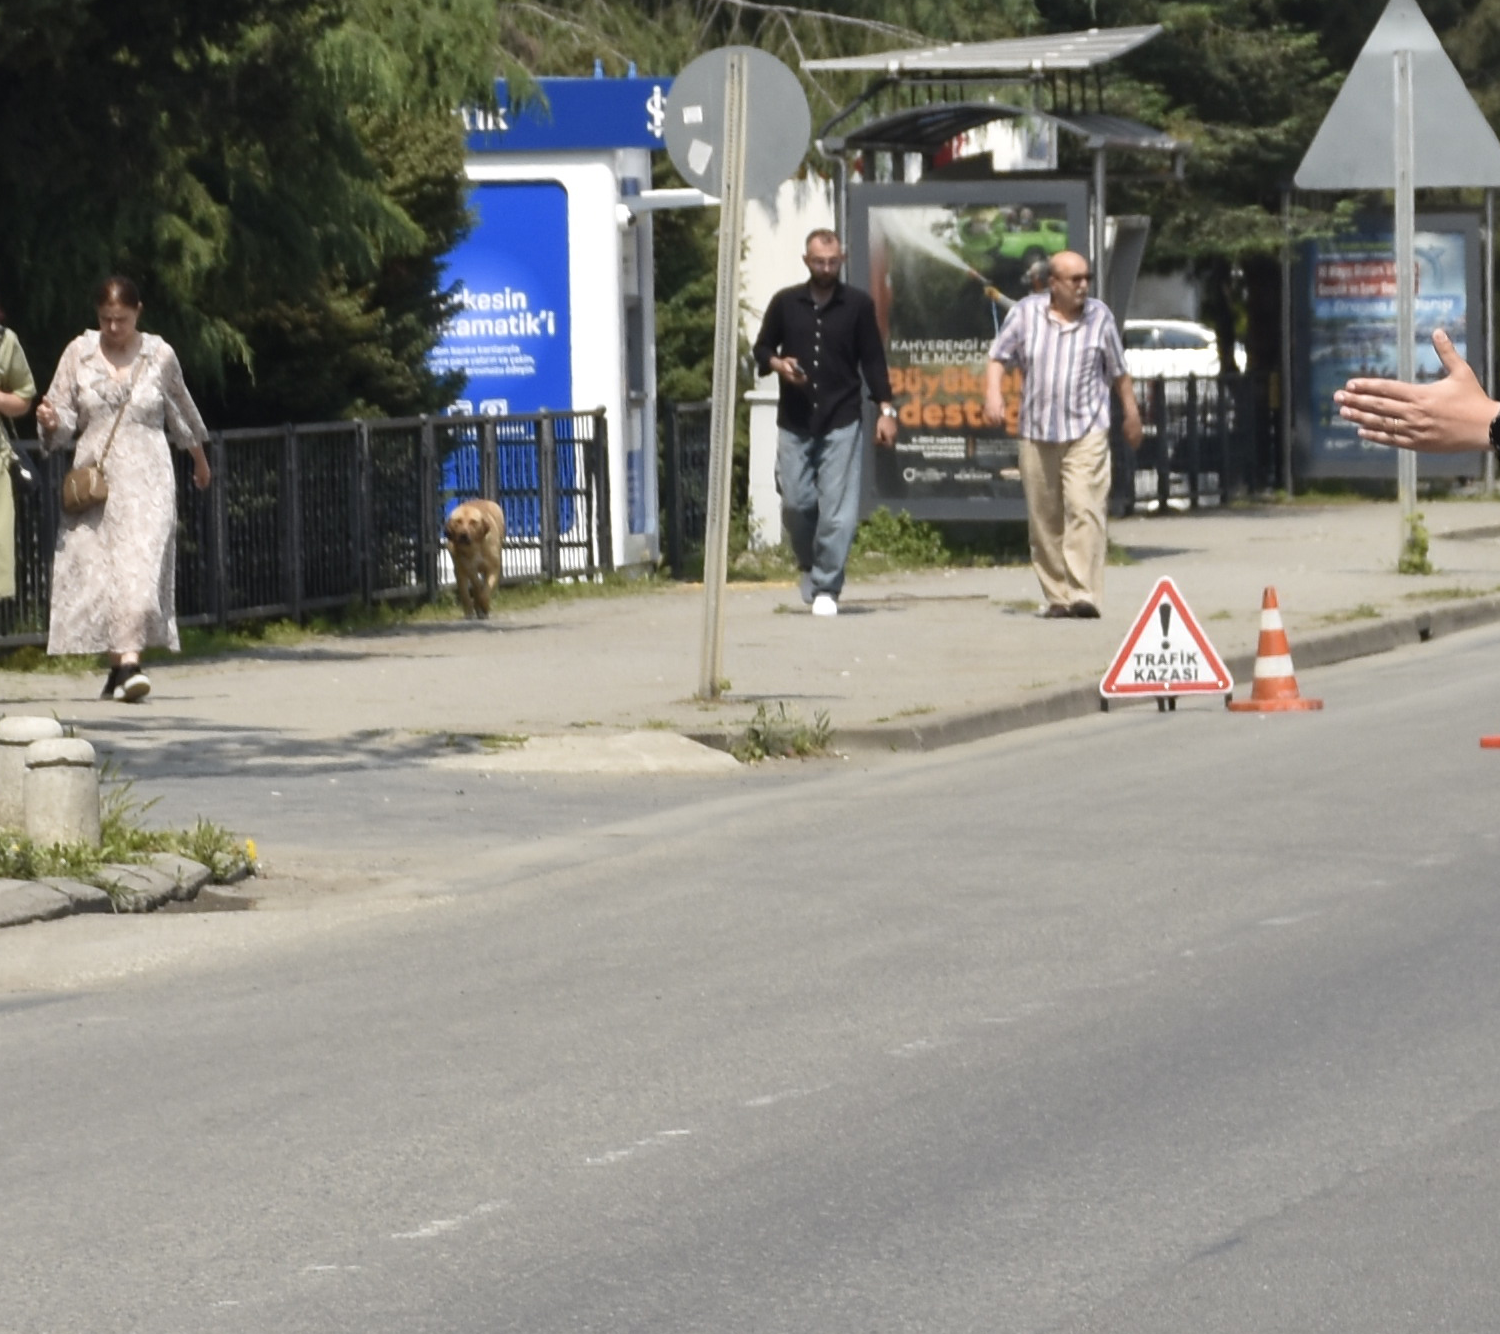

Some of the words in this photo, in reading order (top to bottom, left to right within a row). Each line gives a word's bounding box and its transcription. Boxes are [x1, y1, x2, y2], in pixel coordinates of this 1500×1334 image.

[933, 349, 990, 366] MÜCAD
[1133, 650, 1198, 666] TRAFİK
[1133, 667, 1198, 682] KAZASI
